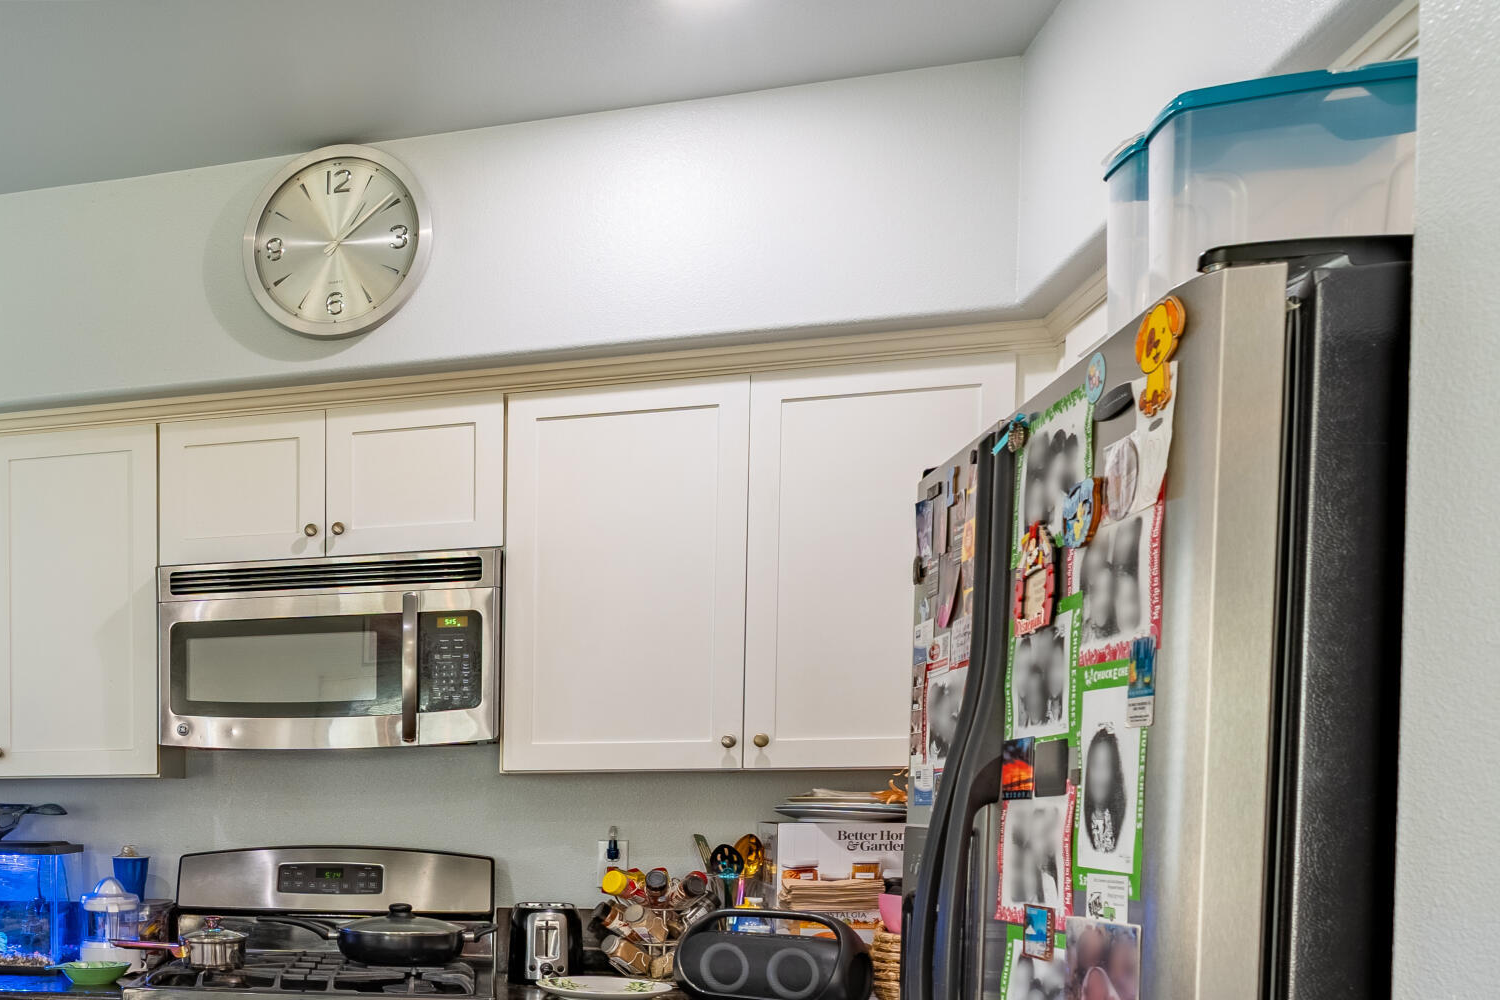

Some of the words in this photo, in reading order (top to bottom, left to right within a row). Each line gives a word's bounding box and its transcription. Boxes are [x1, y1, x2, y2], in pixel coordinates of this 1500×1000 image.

[326, 169, 352, 195] 12
[266, 236, 283, 262] 9
[389, 224, 408, 250] 3
[325, 291, 344, 316] 6
[1093, 669, 1113, 683] CHUCK
[1113, 667, 1119, 680] E
[837, 830, 878, 841] Better
